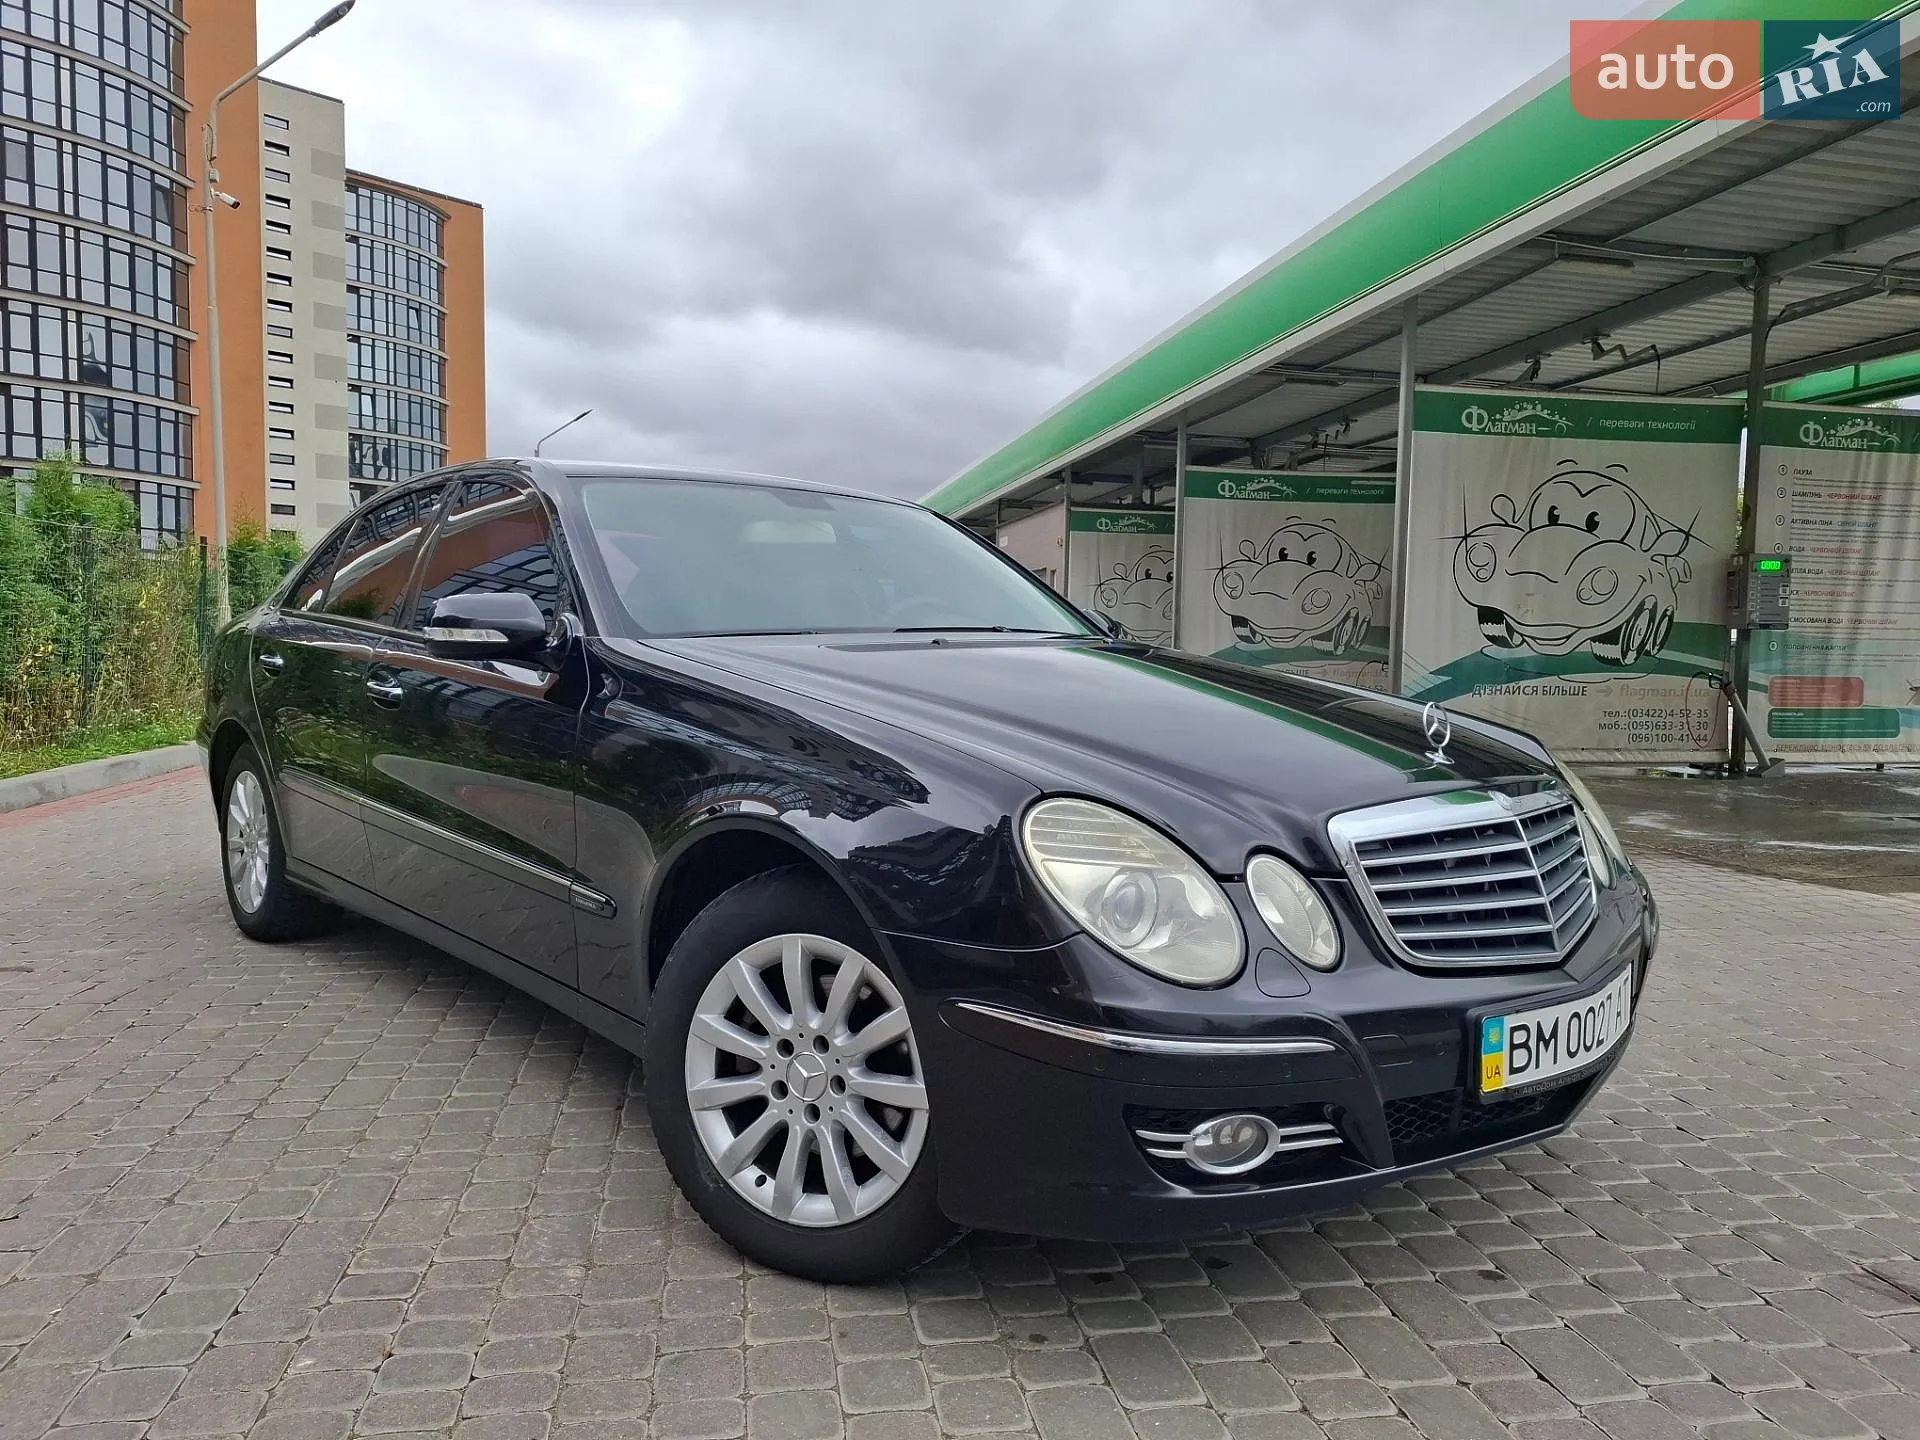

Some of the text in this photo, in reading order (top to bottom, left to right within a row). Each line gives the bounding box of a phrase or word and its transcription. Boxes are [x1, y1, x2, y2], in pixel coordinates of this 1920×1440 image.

[1461, 405, 1536, 434] Флагман
[1599, 418, 1645, 429] переваги
[1648, 419, 1697, 431] технології
[1800, 421, 1867, 448] Флагман
[1217, 480, 1270, 500] Флагман
[1096, 517, 1138, 533] Флагман
[1472, 682, 1588, 698] ДІЗНАЙСЯ БІЛЬШЕ
[1620, 684, 1710, 700] flagman.i.ua
[1598, 720, 1709, 731] моб.:(095)633-3-30
[1509, 1016, 1559, 1076] BM
[1566, 991, 1612, 1059] 0027
[1486, 1066, 1501, 1079] UA
